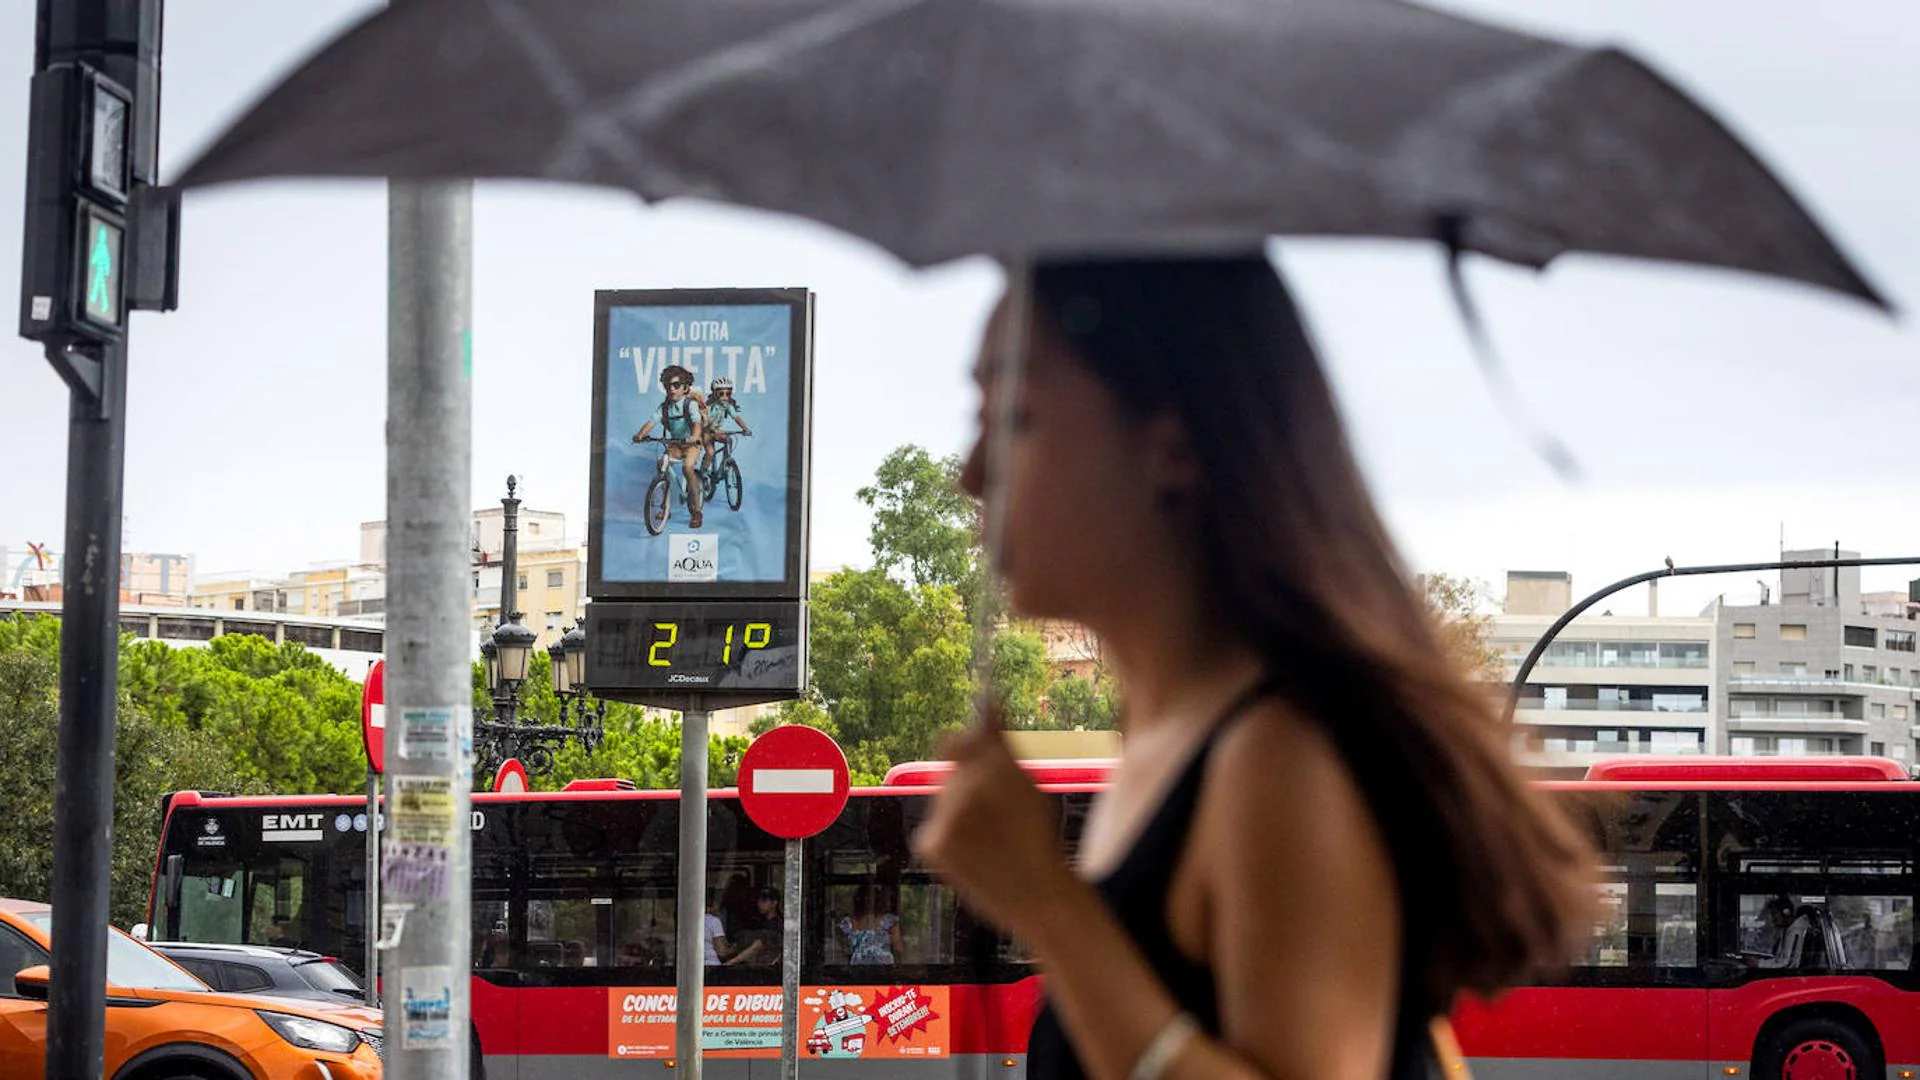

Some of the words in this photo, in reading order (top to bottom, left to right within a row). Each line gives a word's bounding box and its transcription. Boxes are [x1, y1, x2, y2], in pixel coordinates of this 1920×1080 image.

[669, 321, 686, 341] LA
[690, 321, 729, 341] OTRA
[673, 557, 713, 572] AQUA
[668, 674, 710, 683] JCDecaux
[262, 814, 324, 829] EMT
[623, 994, 677, 1012] CONCU
[706, 994, 730, 1012] DE
[622, 1015, 633, 1023] DE
[635, 1015, 645, 1023] LA
[647, 1015, 677, 1023] SETMAN
[703, 1014, 724, 1023] OPEA
[726, 1014, 736, 1023] DE
[738, 1014, 749, 1023] LA
[751, 1014, 783, 1023] MOBILIT
